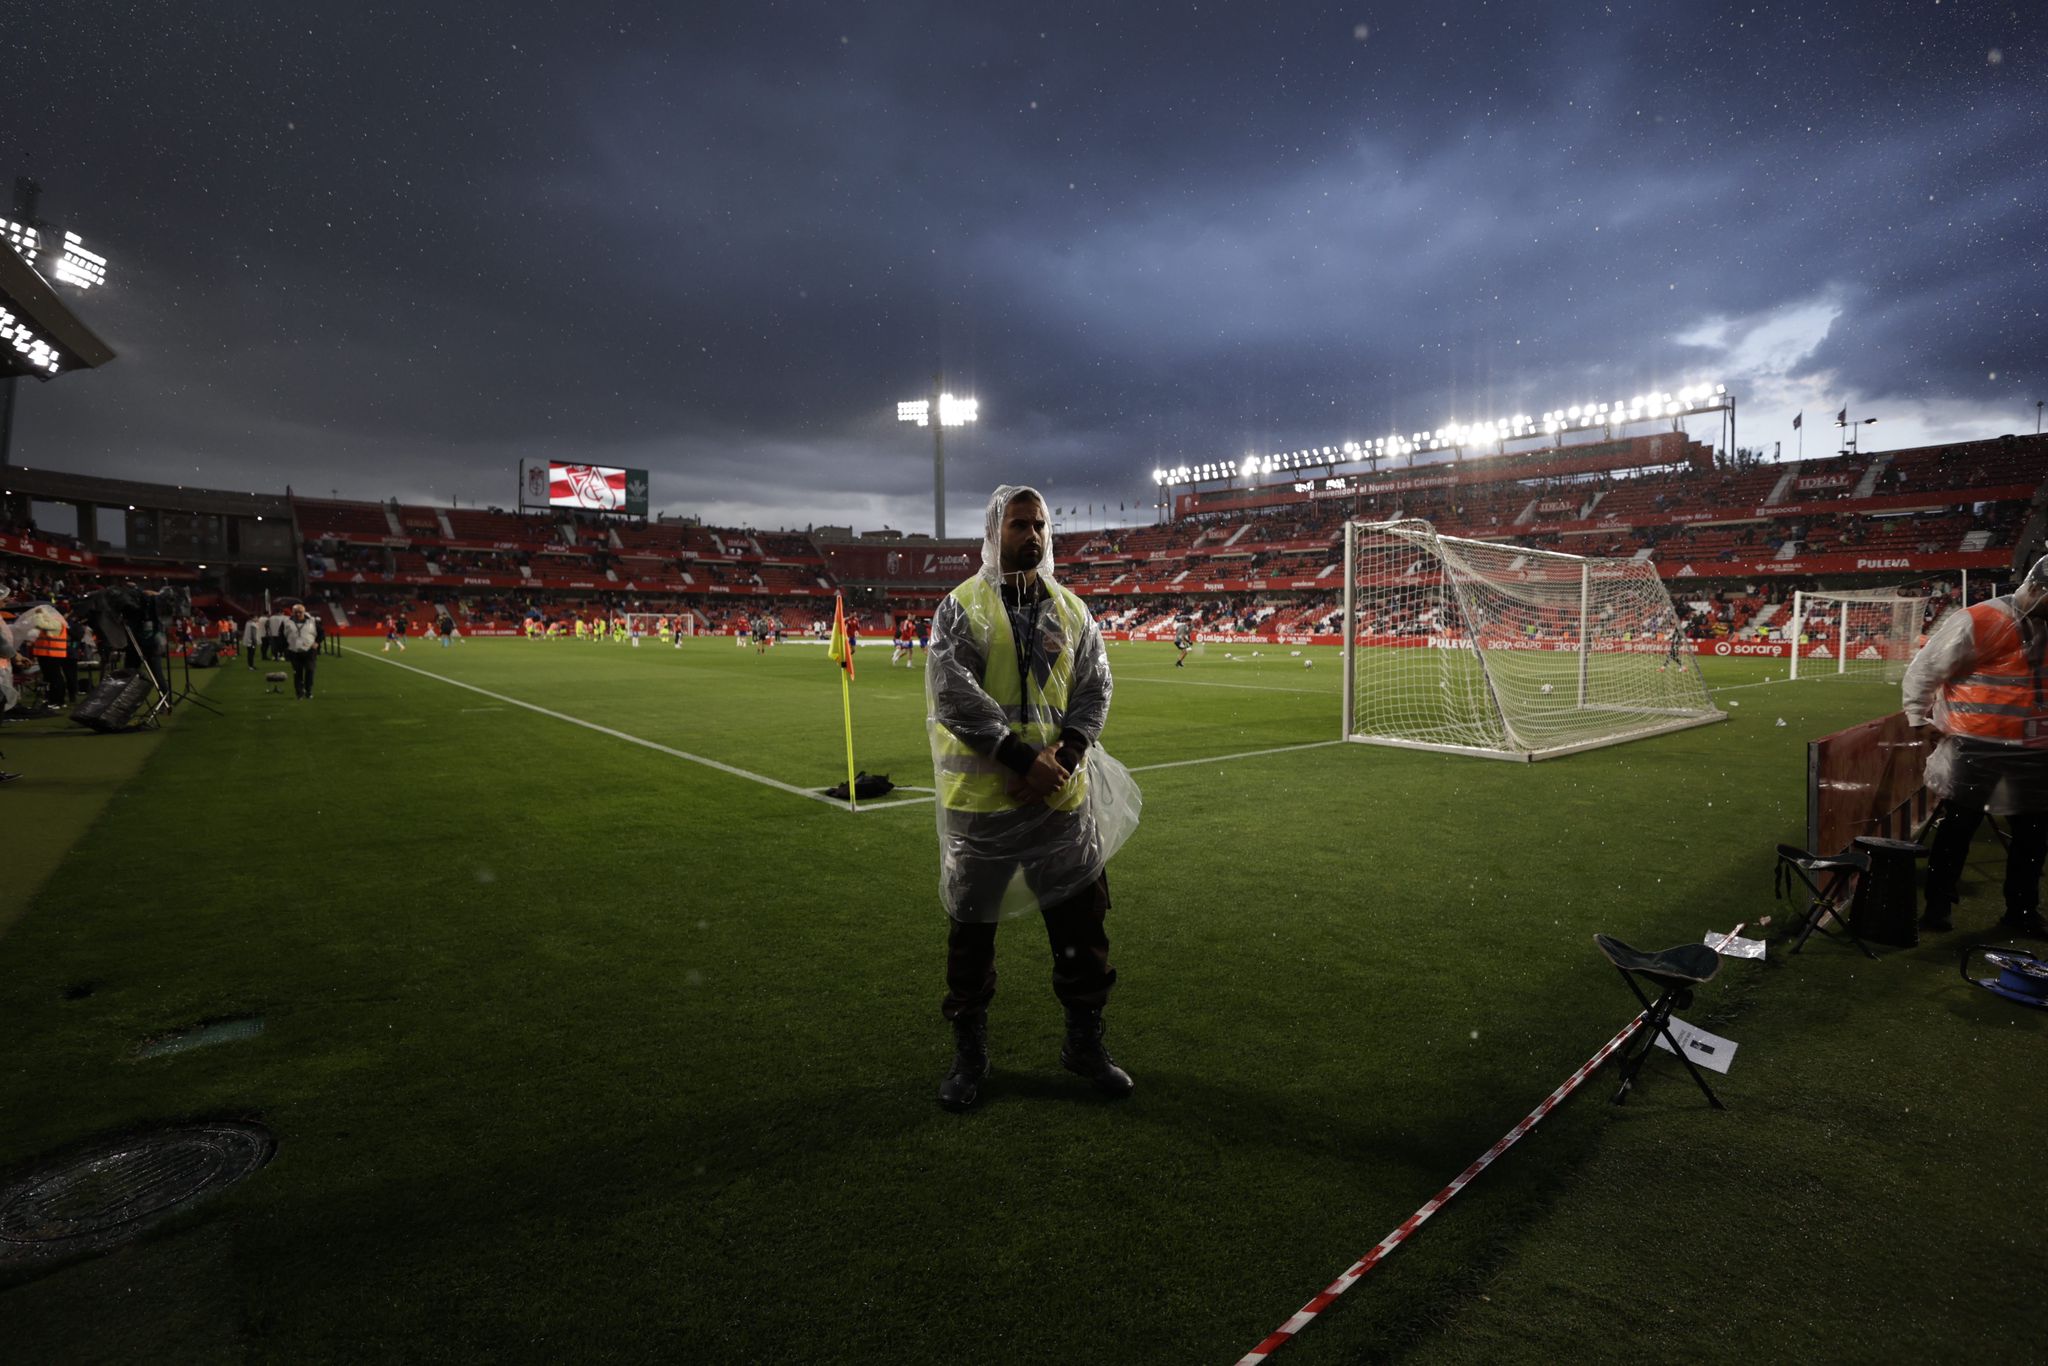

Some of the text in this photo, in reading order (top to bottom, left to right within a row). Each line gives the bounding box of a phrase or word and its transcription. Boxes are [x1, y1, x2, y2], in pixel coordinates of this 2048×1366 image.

[1799, 475, 1848, 488] IDEAL
[1309, 487, 1356, 499] Bienvenidos
[1369, 482, 1395, 492] Nuevo
[1539, 501, 1570, 512] IDEAL
[1856, 558, 1910, 569] PULEVA
[1428, 638, 1474, 649] PULEVA
[1734, 644, 1782, 655] sorare
